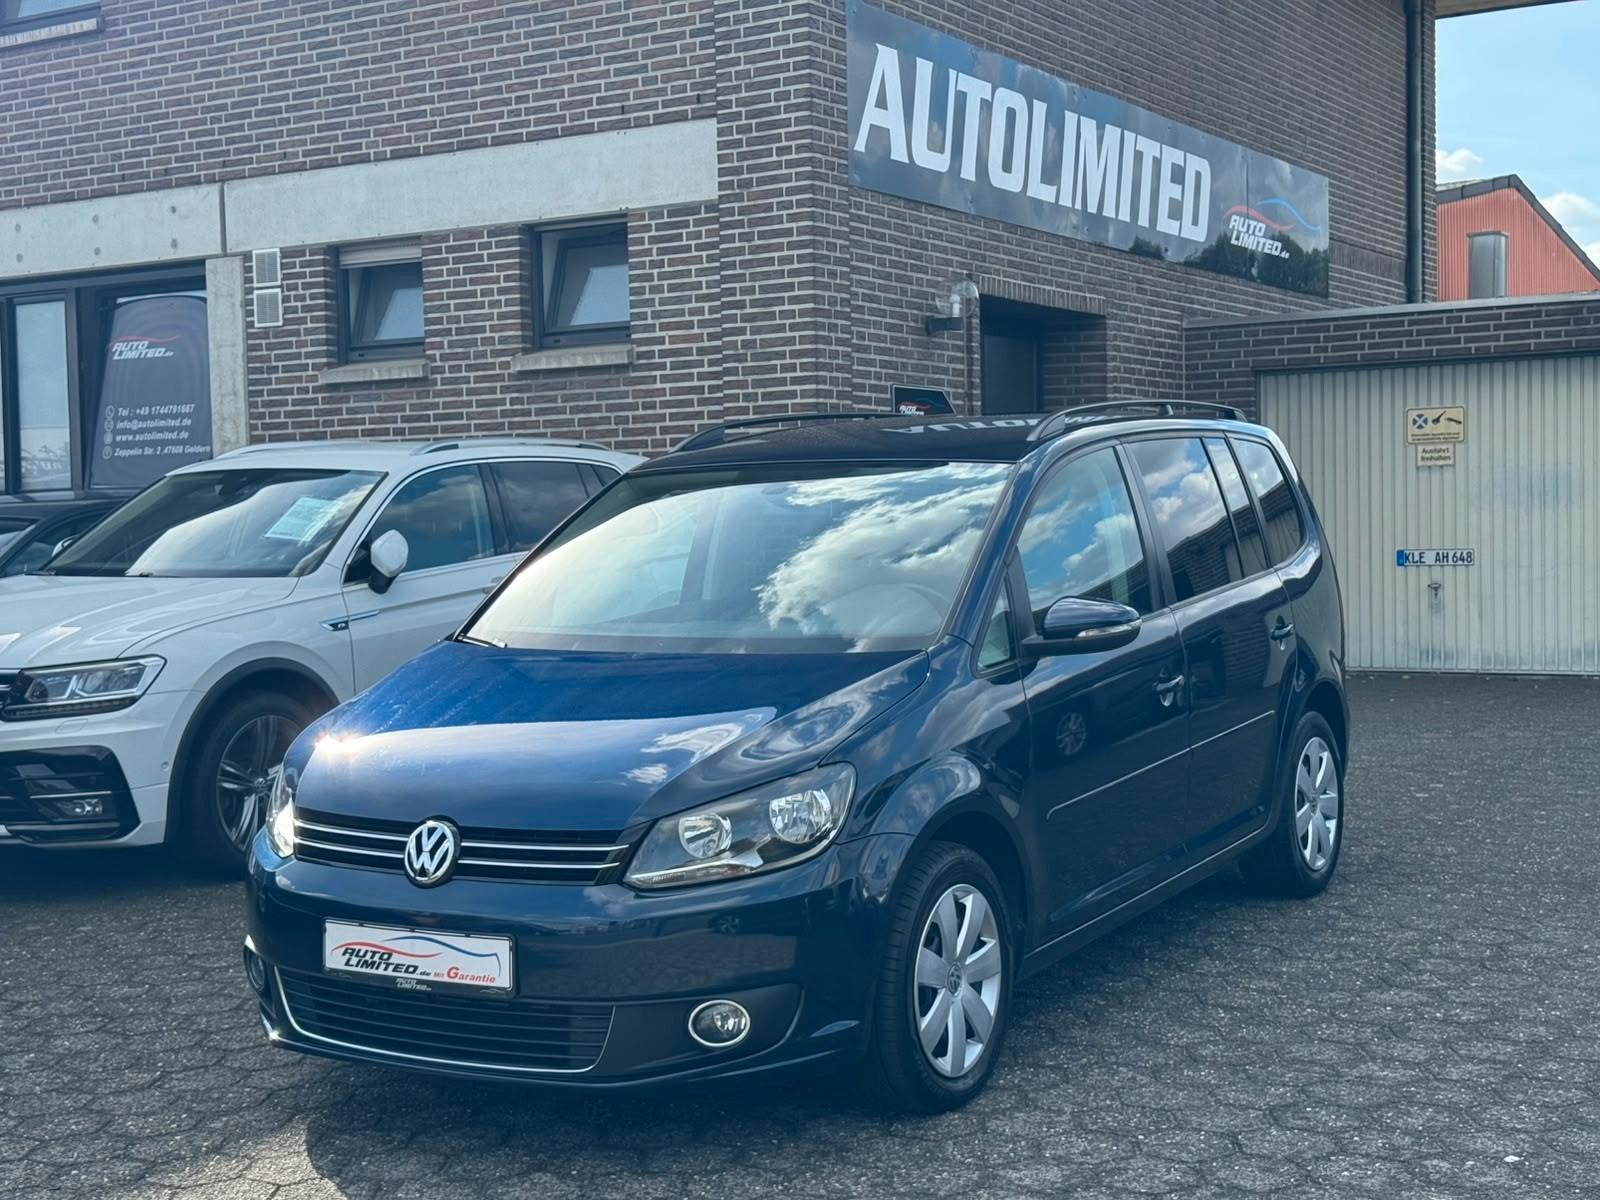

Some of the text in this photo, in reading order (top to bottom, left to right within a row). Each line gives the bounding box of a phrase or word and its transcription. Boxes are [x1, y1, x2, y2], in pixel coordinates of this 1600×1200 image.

[853, 42, 1212, 243] AUTOLIMITED
[1229, 214, 1266, 237] AUTO
[112, 340, 149, 353] AUTO
[115, 430, 189, 442] www.autolimited.de
[1404, 550, 1473, 564] KLE AH 648
[342, 947, 393, 961] AUTO
[344, 957, 432, 977] LIMITED.de
[446, 966, 496, 984] Garantie
